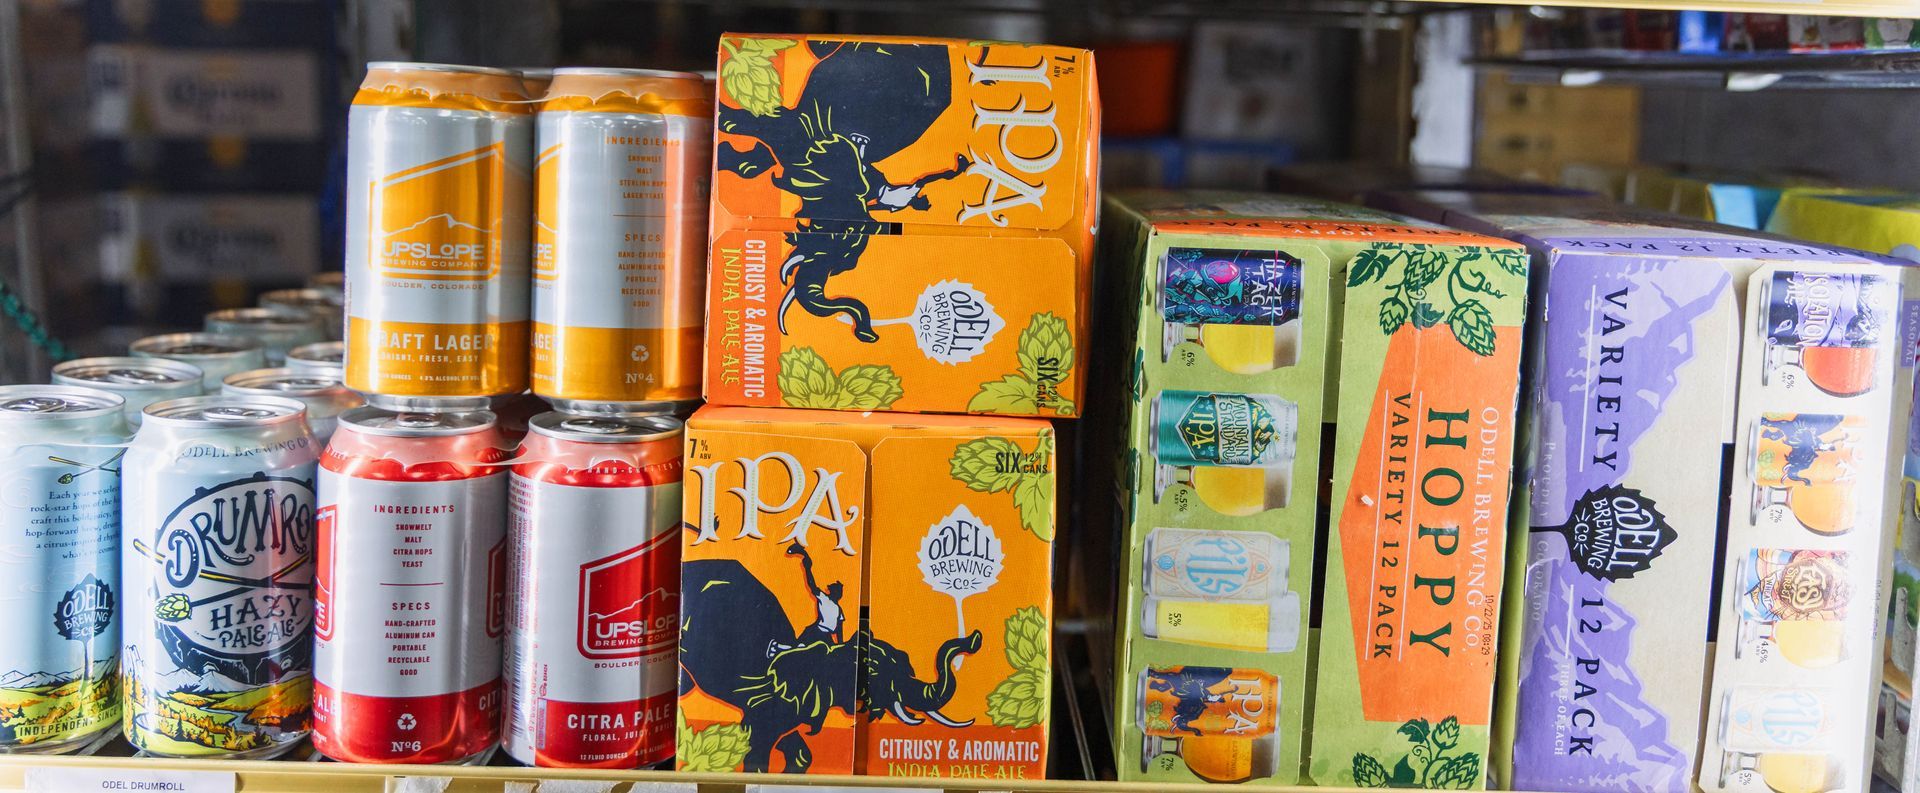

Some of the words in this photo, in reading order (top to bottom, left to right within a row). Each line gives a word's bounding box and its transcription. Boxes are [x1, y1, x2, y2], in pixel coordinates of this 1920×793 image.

[957, 53, 1064, 228] IPA
[382, 242, 485, 259] UPSLOPE
[625, 233, 662, 243] SPECS
[720, 247, 742, 302] INDIA
[744, 238, 767, 303] CITRUSY
[1250, 263, 1266, 306] TAG
[1261, 258, 1286, 317] HAZER
[721, 309, 741, 350] PALE
[745, 307, 767, 328] &
[932, 291, 952, 355] BREWING
[948, 290, 990, 356] ODELL
[434, 334, 494, 350] LAGER
[1904, 304, 1920, 364] SEASONAL
[719, 354, 740, 386] ALE
[743, 324, 766, 399] AROMATIC
[1036, 356, 1060, 382] SIX
[1186, 351, 1195, 367] 6%
[1593, 286, 1629, 472] VARIETY
[1786, 374, 1795, 389] 6%
[1036, 384, 1047, 408] CANS
[1185, 411, 1216, 449] IPA
[1218, 401, 1236, 460] STANDARD
[1231, 399, 1250, 458] MOUNTAIN
[235, 440, 296, 457] BREWING
[1384, 392, 1412, 525] VARIETY
[1476, 406, 1500, 485] ODELL
[995, 451, 1021, 473] SIX
[1023, 464, 1048, 474] CANS
[30, 503, 70, 512] rock-star
[49, 491, 71, 500] Each
[374, 503, 455, 514] INGREDIENTS
[689, 451, 860, 556] IPA
[1179, 489, 1188, 512] 6.5%
[25, 528, 79, 538] hop-forward
[31, 516, 52, 525] craft
[54, 515, 70, 523] this
[395, 523, 432, 531] SNOWMELT
[1409, 407, 1470, 658] HOPPY
[166, 488, 316, 588] DRUMRO
[928, 519, 996, 563] ODELL
[1586, 497, 1614, 570] BREWING
[1605, 496, 1661, 571] ODELL
[415, 548, 433, 556] HOPS
[1381, 541, 1399, 568] 12
[1466, 493, 1492, 608] BREWING
[401, 560, 423, 568] YEAST
[930, 559, 994, 578] BREWING
[1763, 579, 1774, 603] WHEAT
[1781, 567, 1799, 603] STREET
[63, 584, 110, 618] ODELL
[211, 594, 303, 631] HAZY
[391, 602, 431, 611] SPECS
[64, 610, 108, 630] BREWING
[384, 618, 436, 627] HAND-CRAFTED
[595, 613, 678, 639] UPSLOP
[1173, 612, 1182, 627] 5%
[1373, 584, 1397, 659] PACK
[1579, 596, 1604, 634] 12
[219, 624, 266, 649] PALE
[267, 619, 296, 642] ALE
[595, 637, 644, 647] BREWING
[388, 656, 431, 664] RECYCLABLE
[392, 644, 427, 652] PORTABLE
[1759, 641, 1769, 664] 4.6%
[594, 660, 643, 669] BOULDER,
[1557, 663, 1571, 703] THREE
[567, 713, 625, 729] CITRA
[633, 703, 671, 726] PALE
[1223, 677, 1265, 735] IPA
[1556, 705, 1567, 724] OF
[1568, 656, 1600, 756] PACK
[583, 733, 621, 742] FLORAL,
[879, 738, 943, 760] CITRUSY
[947, 738, 960, 760] &
[962, 740, 1040, 762] AROMATIC
[1554, 724, 1566, 756] EACH
[588, 753, 605, 761] FLUID
[606, 752, 629, 760] OUNCES
[1165, 757, 1174, 771] 7%
[888, 762, 942, 779] INDIA
[102, 780, 128, 790] ODEL
[130, 781, 185, 791] DRUMROLL
